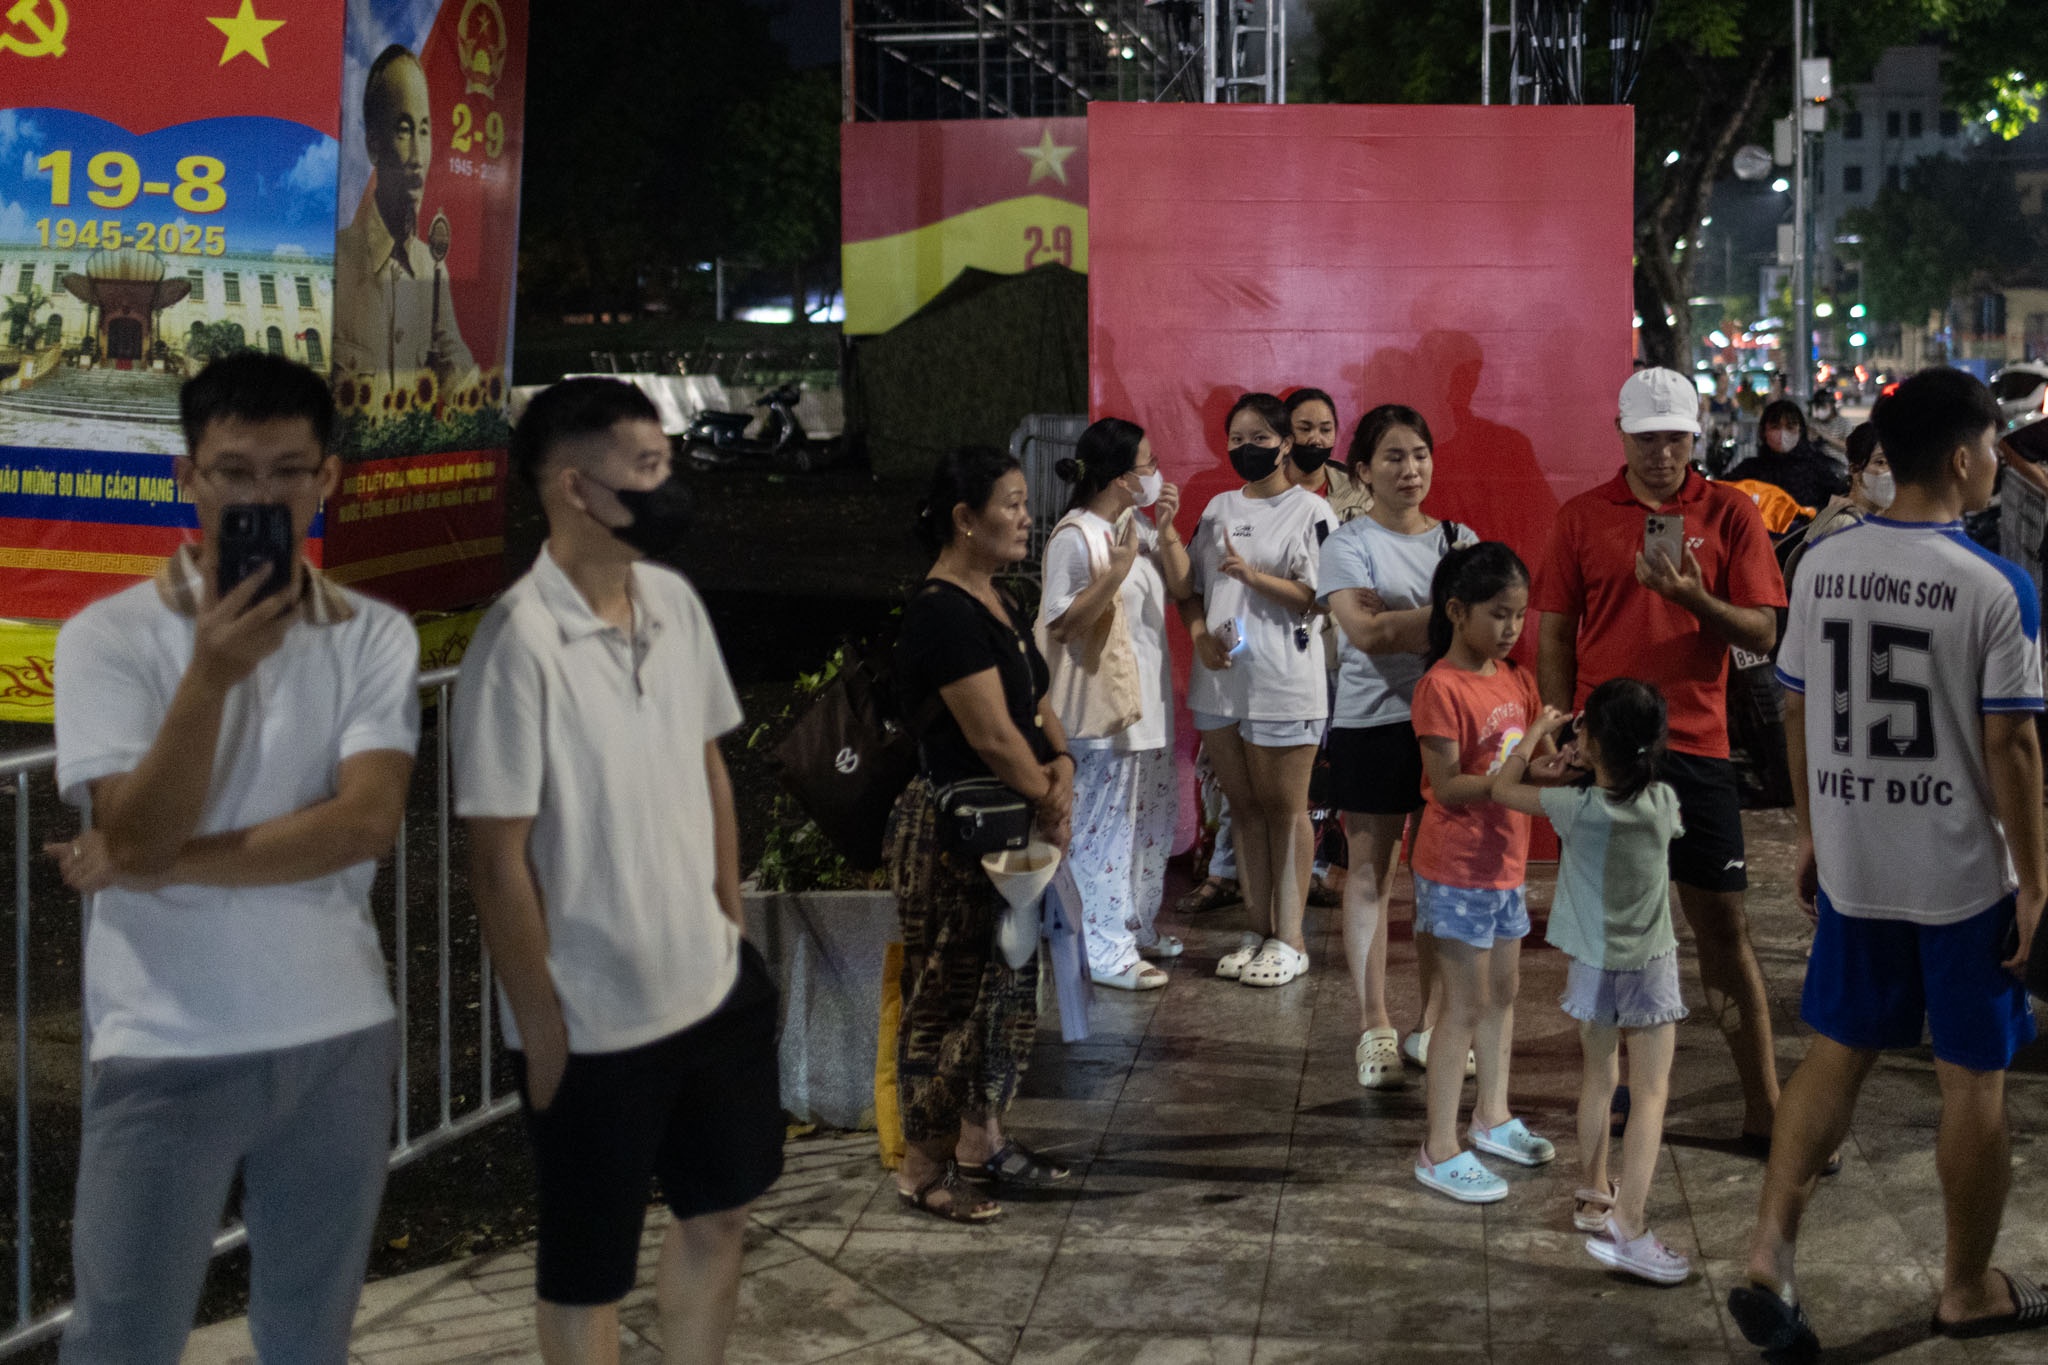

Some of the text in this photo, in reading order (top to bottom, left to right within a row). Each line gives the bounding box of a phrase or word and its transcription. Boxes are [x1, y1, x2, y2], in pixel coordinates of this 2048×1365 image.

[451, 103, 504, 158] 2-9
[38, 150, 227, 214] 19-8
[36, 218, 226, 257] 1945-2025
[1023, 225, 1073, 271] 2-9
[21, 465, 57, 496] MỪNG
[59, 472, 73, 497] 80
[75, 468, 103, 498] NĂM
[105, 470, 136, 500] CÁCH
[139, 476, 173, 507] MẠNG
[1814, 572, 1957, 612] U18 LƯƠNG SƠN
[1821, 617, 1937, 761] 15
[1817, 768, 1953, 806] VIỆT ĐỨC
